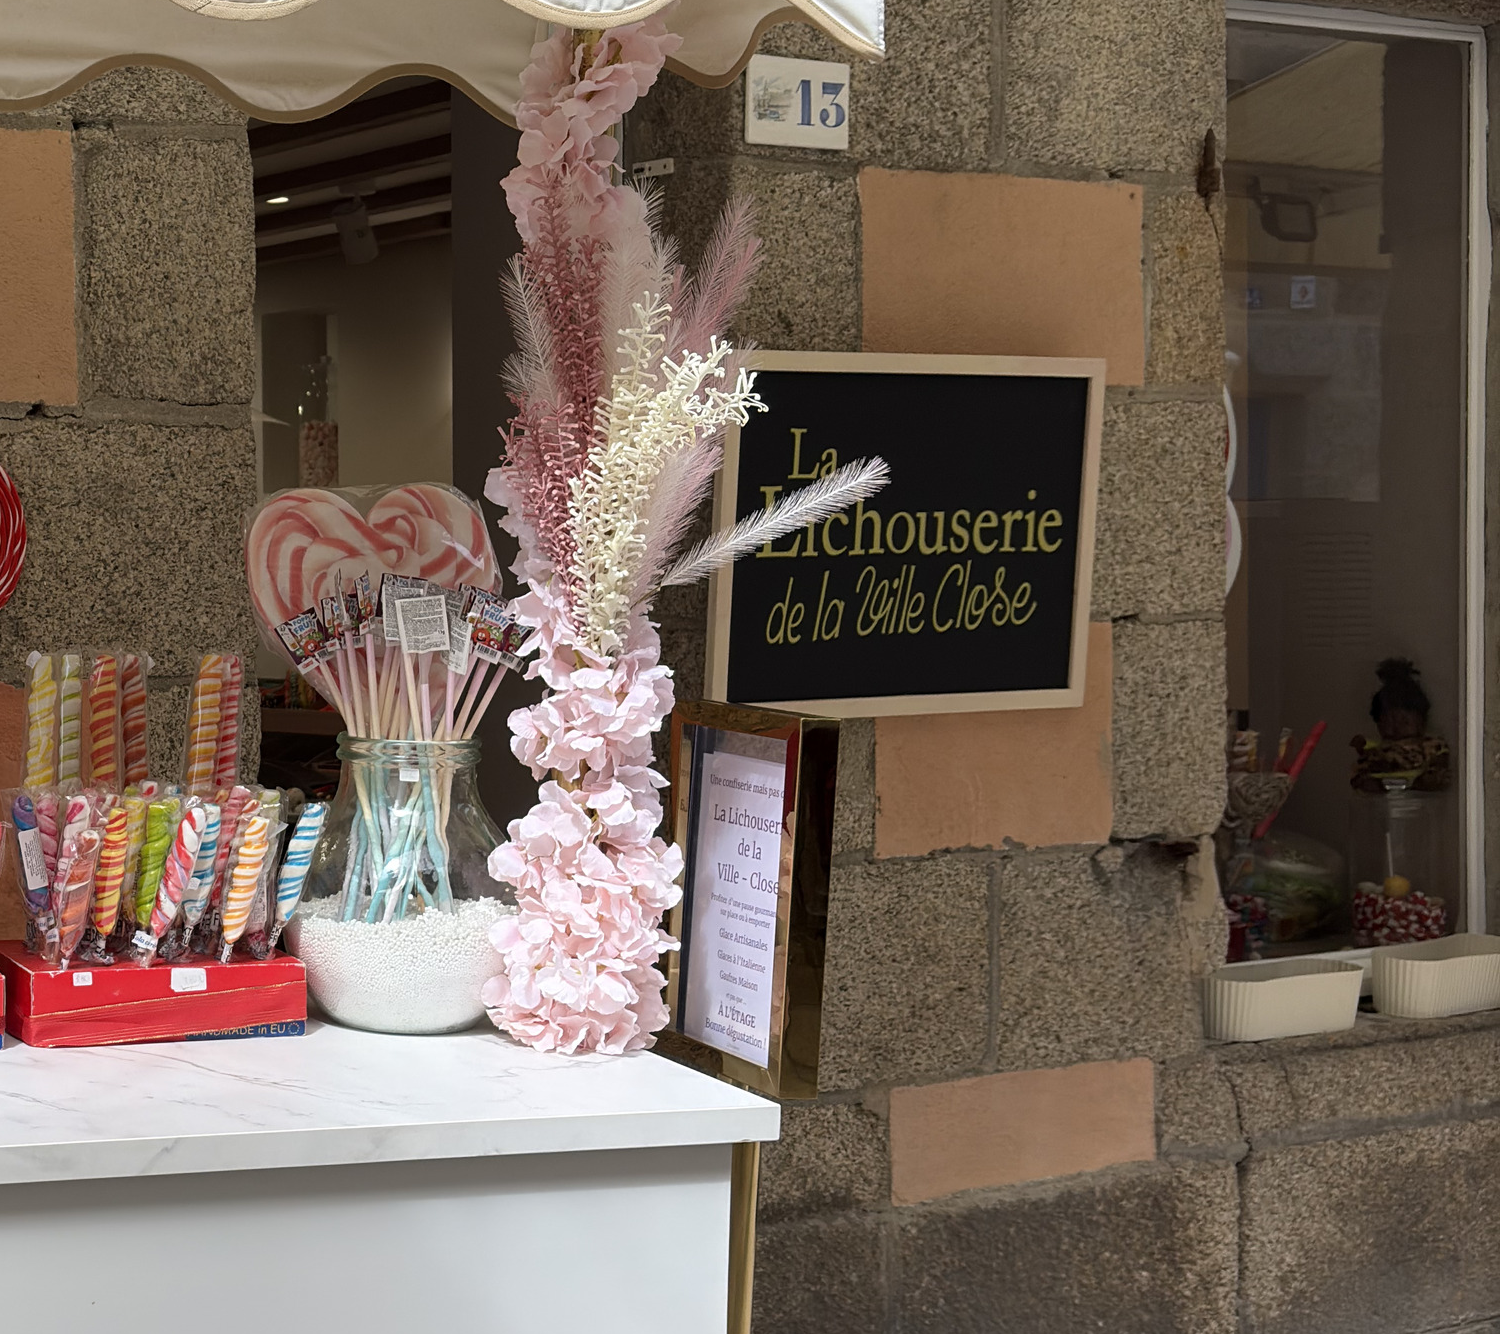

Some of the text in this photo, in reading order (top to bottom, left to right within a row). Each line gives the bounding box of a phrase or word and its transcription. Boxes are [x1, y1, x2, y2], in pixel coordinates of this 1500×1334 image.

[795, 79, 846, 128] 13
[787, 428, 839, 480] La
[755, 485, 1063, 559] Lichouserie
[766, 560, 1037, 644] de la Ville Close
[709, 773, 722, 786] Une
[722, 778, 752, 793] confiserie
[752, 783, 768, 796] mais
[768, 788, 780, 799] pas
[713, 803, 726, 823] La
[737, 837, 762, 861] de la
[717, 862, 740, 885] Ville
[749, 870, 781, 895] Close
[726, 910, 739, 920] place
[748, 916, 771, 929] emporter
[718, 926, 769, 952] Glace Artisanales
[717, 948, 733, 963] Glaces
[737, 976, 759, 993] Maison
[717, 1000, 757, 1029] À L'ÉTAGE
[257, 1024, 268, 1035] in
[270, 1023, 286, 1035] EU
[705, 1016, 726, 1035] Bonne
[725, 1024, 763, 1050] dégustation
